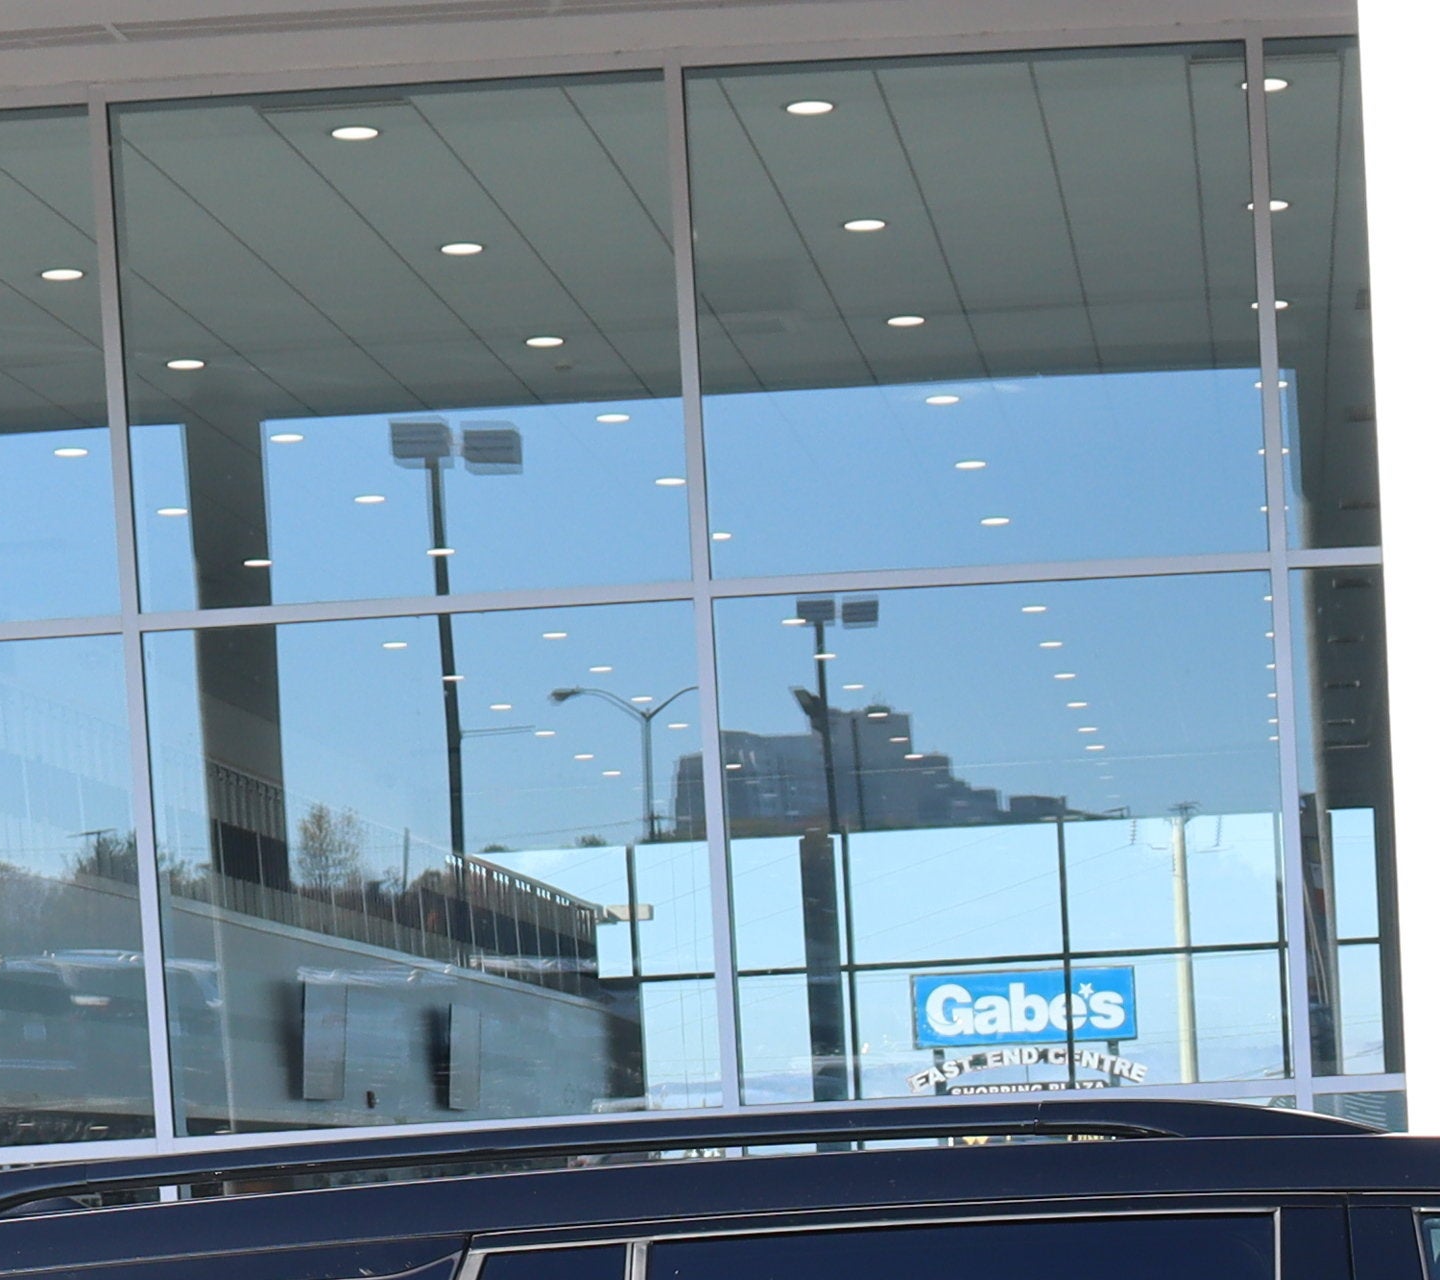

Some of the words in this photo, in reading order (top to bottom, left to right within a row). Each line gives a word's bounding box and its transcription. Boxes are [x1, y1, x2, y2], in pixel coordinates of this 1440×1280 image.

[908, 1056, 974, 1093] EAST
[985, 1047, 1039, 1069] END
[1047, 1048, 1148, 1083] CENTRE
